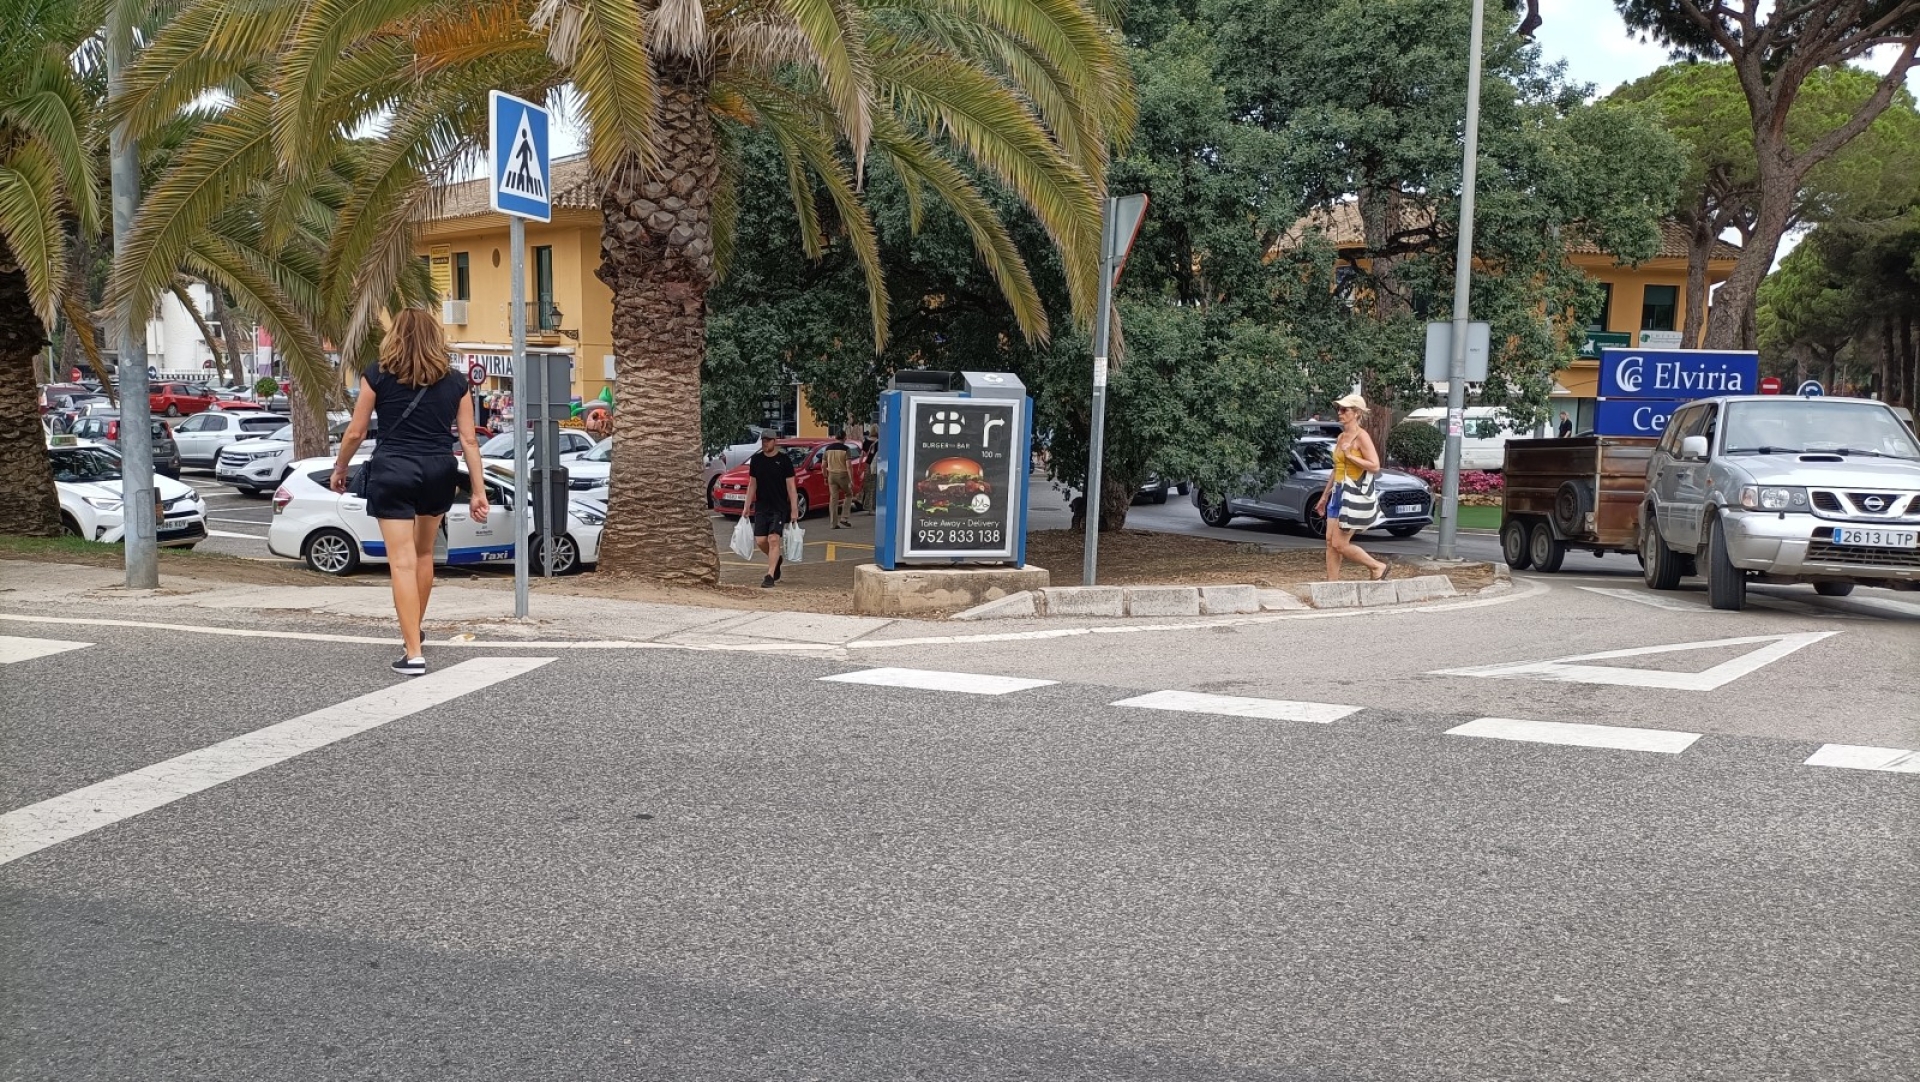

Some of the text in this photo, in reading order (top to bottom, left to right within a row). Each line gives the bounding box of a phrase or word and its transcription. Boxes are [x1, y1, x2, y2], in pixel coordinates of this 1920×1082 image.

[473, 369, 483, 380] 20
[1653, 361, 1742, 391] Elviria
[981, 450, 993, 458] 100
[920, 519, 1000, 530] Take Away Delivery
[918, 529, 1001, 543] 952 833 138
[1843, 530, 1914, 546] 2613 LTP
[481, 550, 509, 561] Taxi
